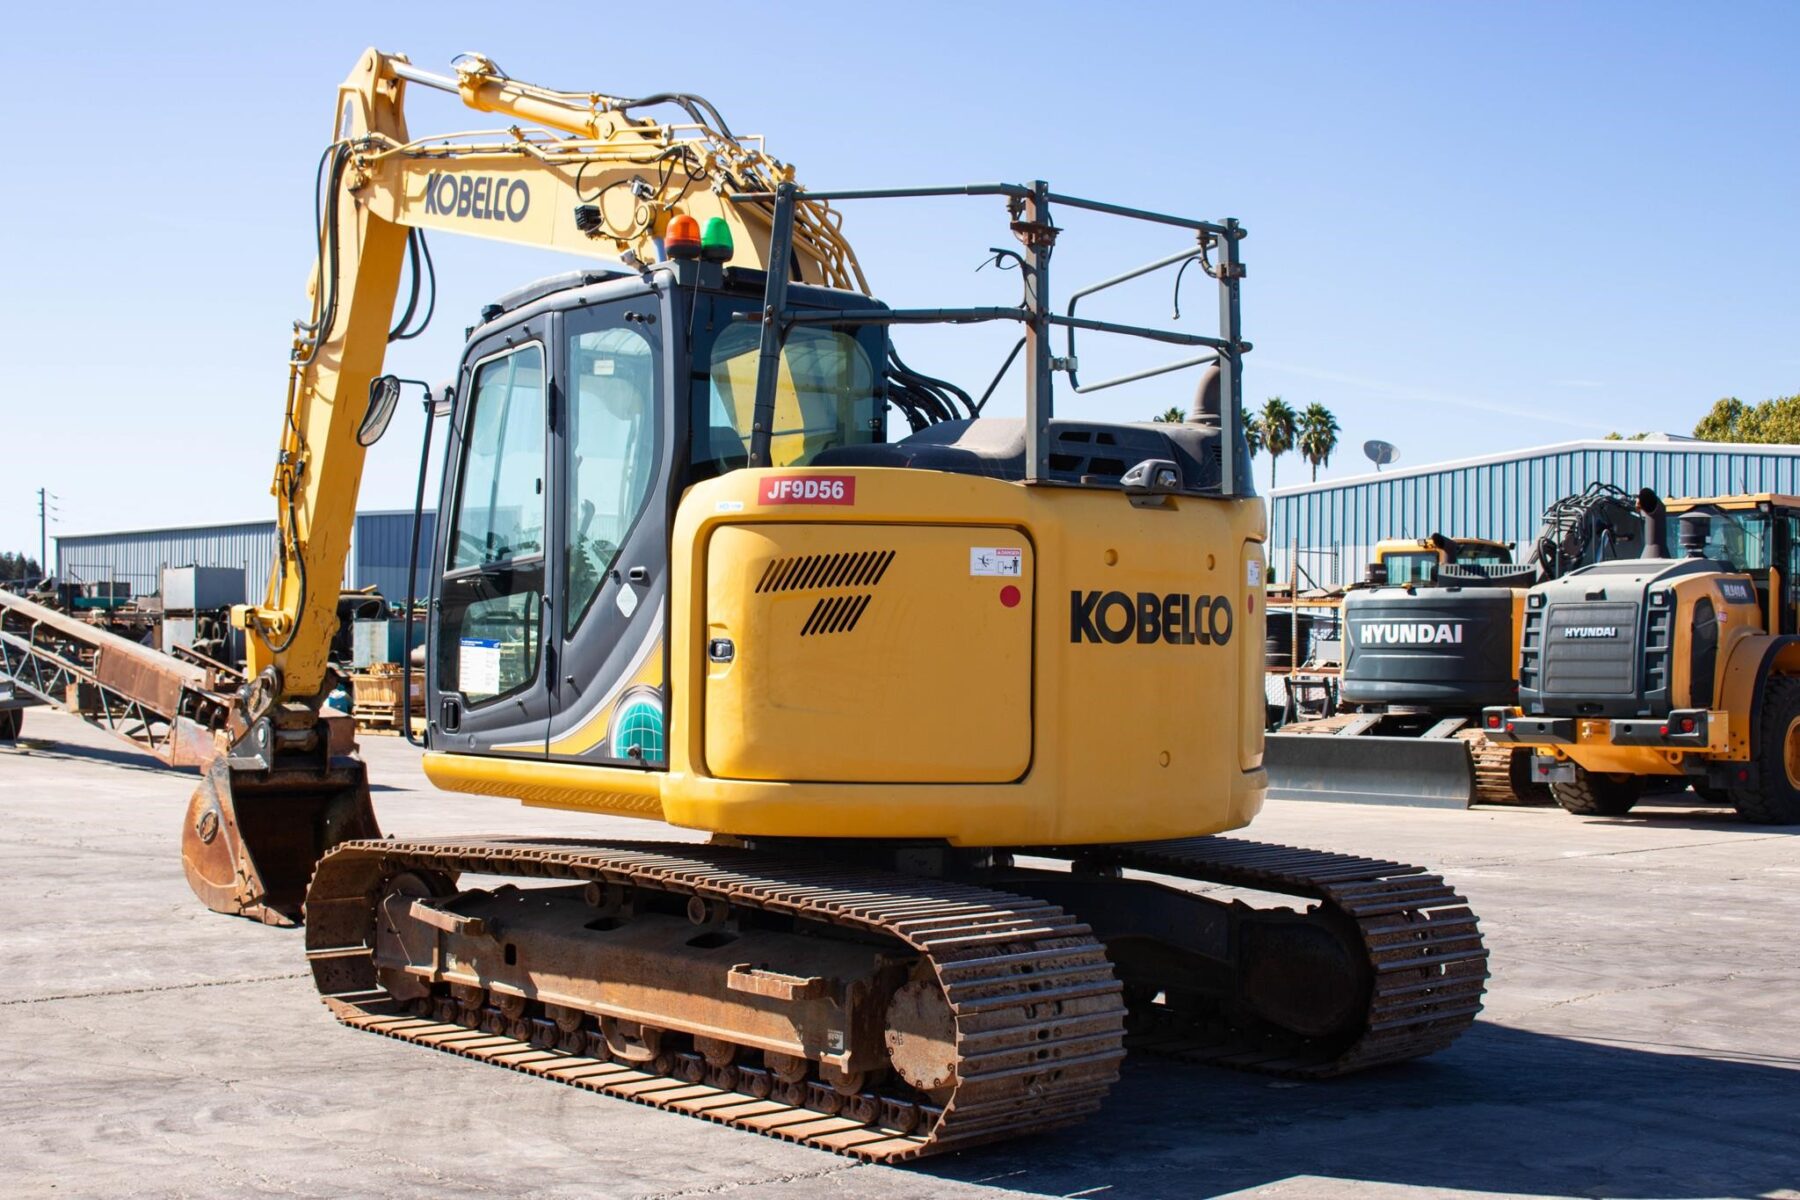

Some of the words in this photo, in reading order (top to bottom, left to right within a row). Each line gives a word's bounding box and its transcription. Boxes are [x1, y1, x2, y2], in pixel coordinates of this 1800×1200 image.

[425, 173, 530, 222] KOBELCO
[767, 480, 844, 499] JF9D56
[1070, 590, 1233, 646] KOBELCO
[1361, 624, 1463, 643] HYUNDAI
[1565, 627, 1616, 637] HYUNDAI
